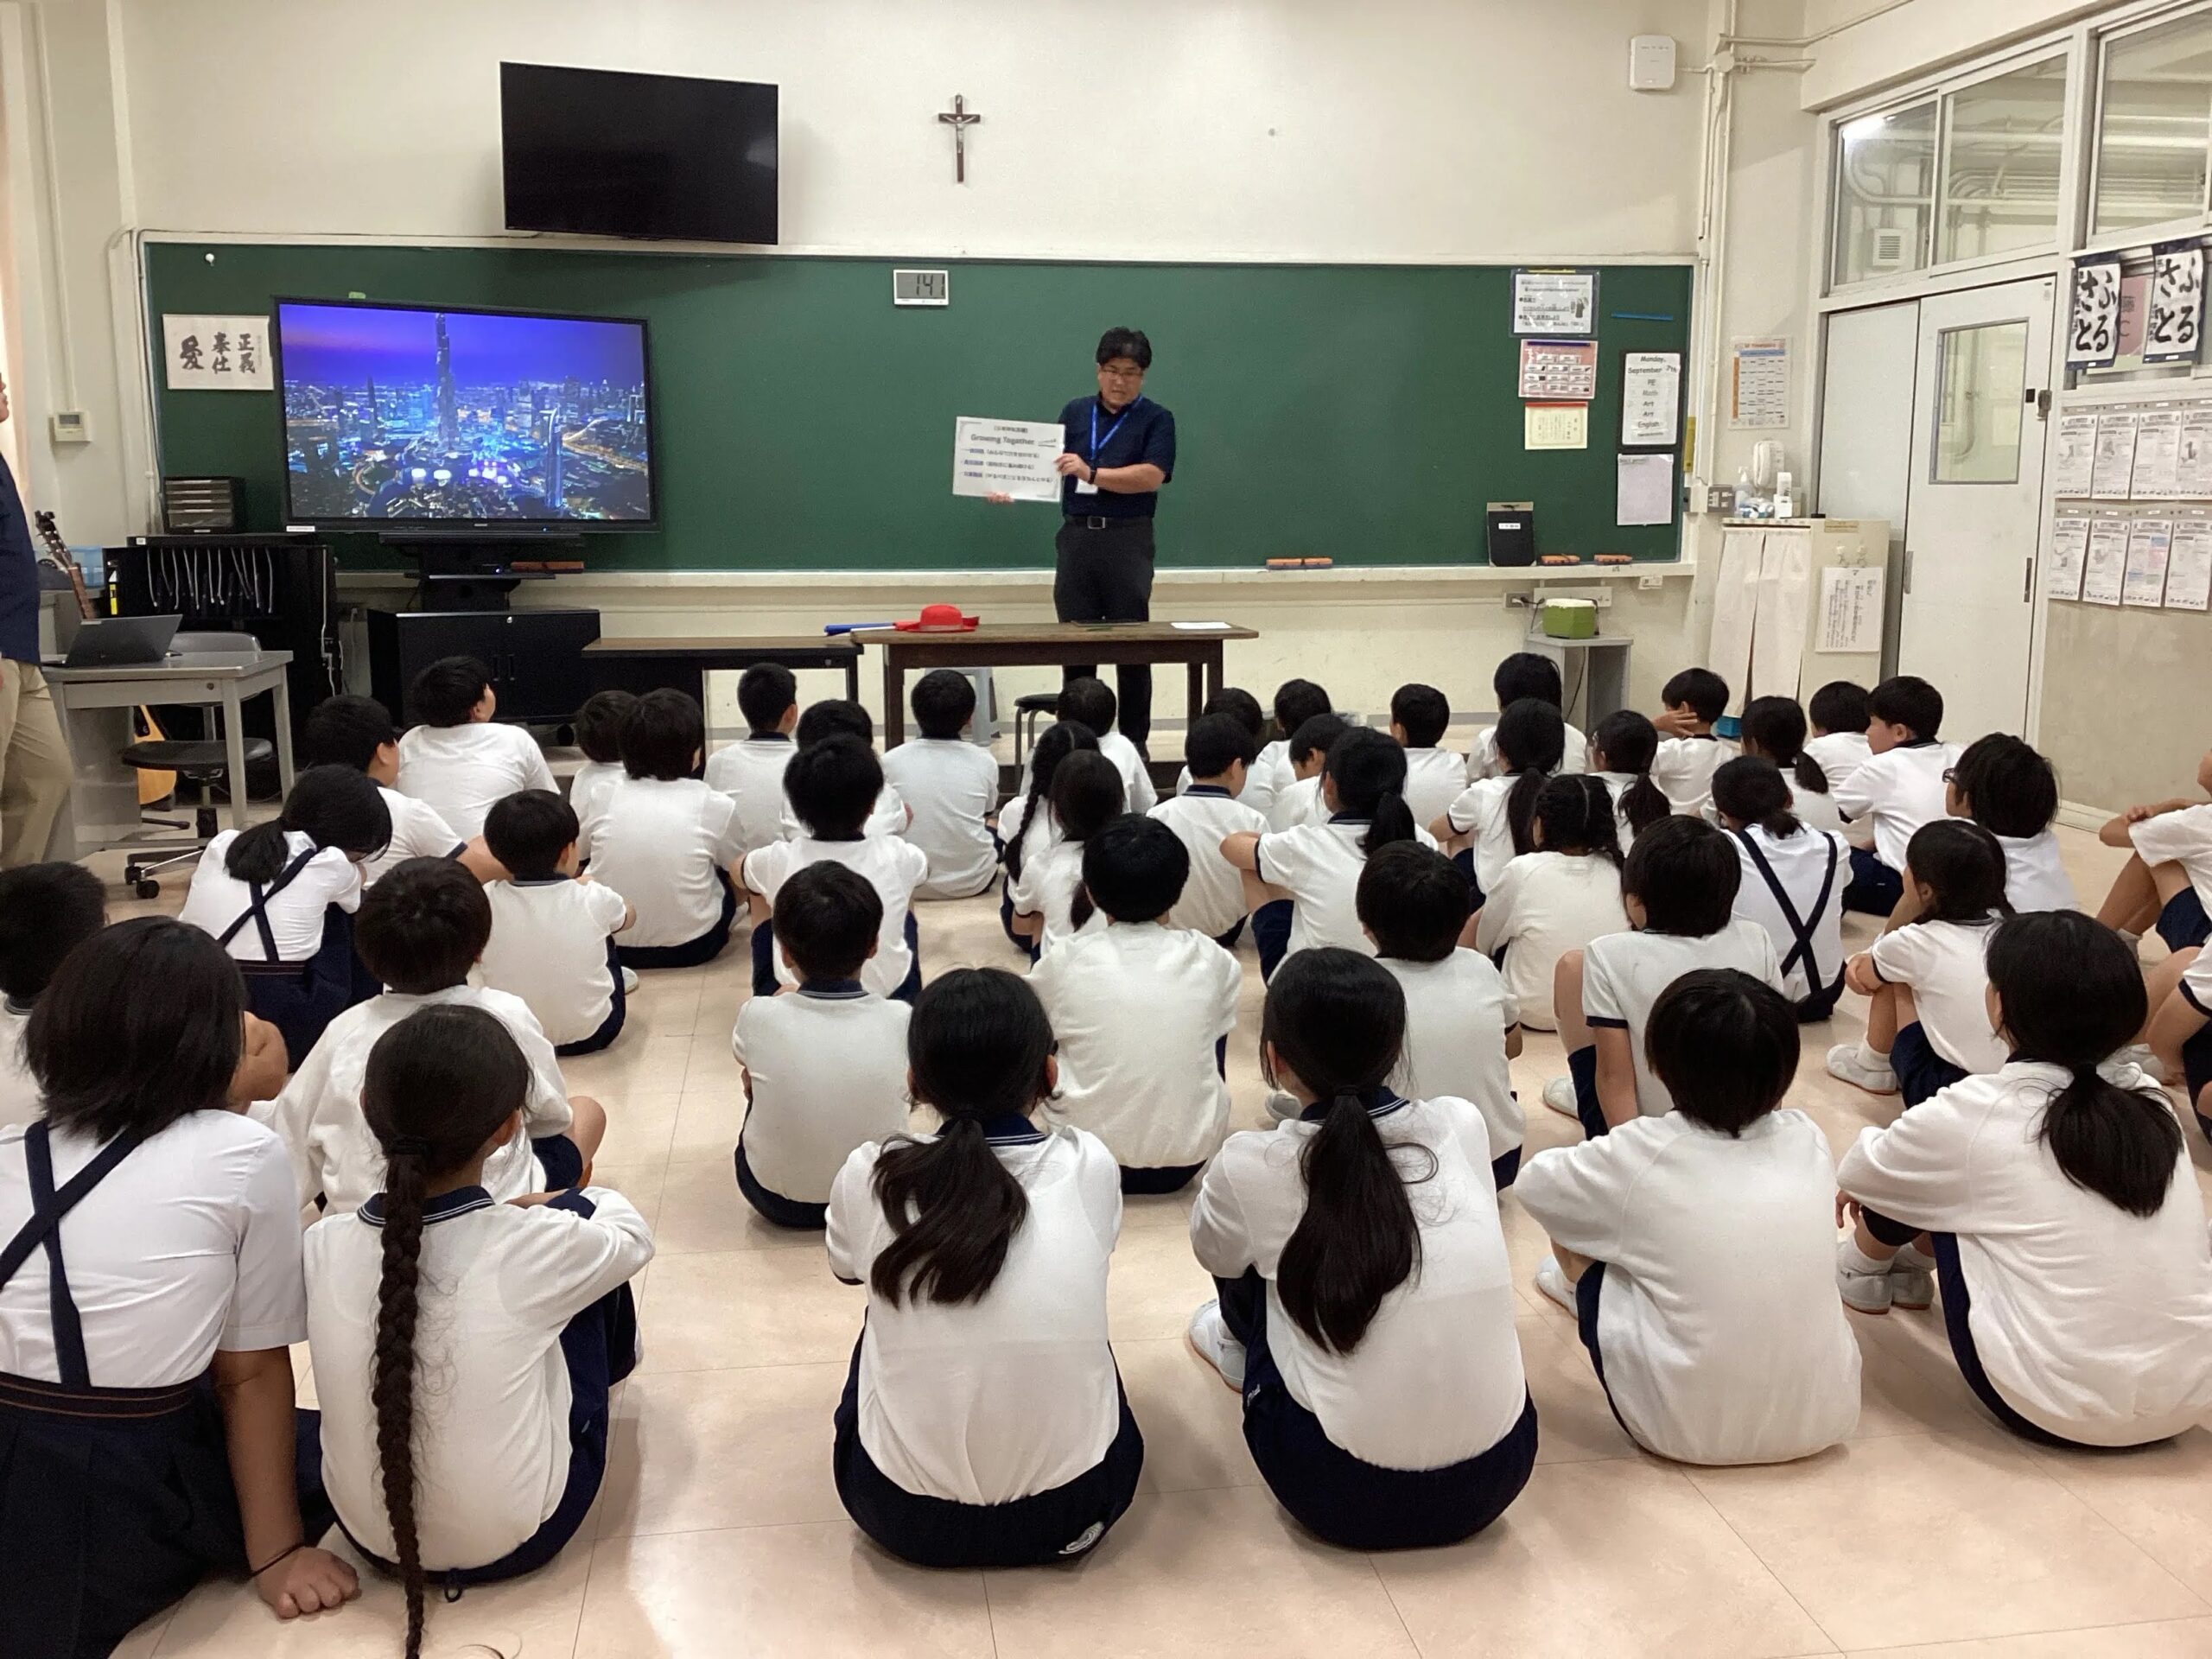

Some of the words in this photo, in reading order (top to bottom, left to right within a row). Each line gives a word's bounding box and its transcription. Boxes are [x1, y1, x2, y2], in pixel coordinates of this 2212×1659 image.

[1627, 366, 1662, 375] September
[1637, 421, 1660, 429] English
[970, 433, 1001, 444] Growing
[1002, 435, 1035, 446] Together
